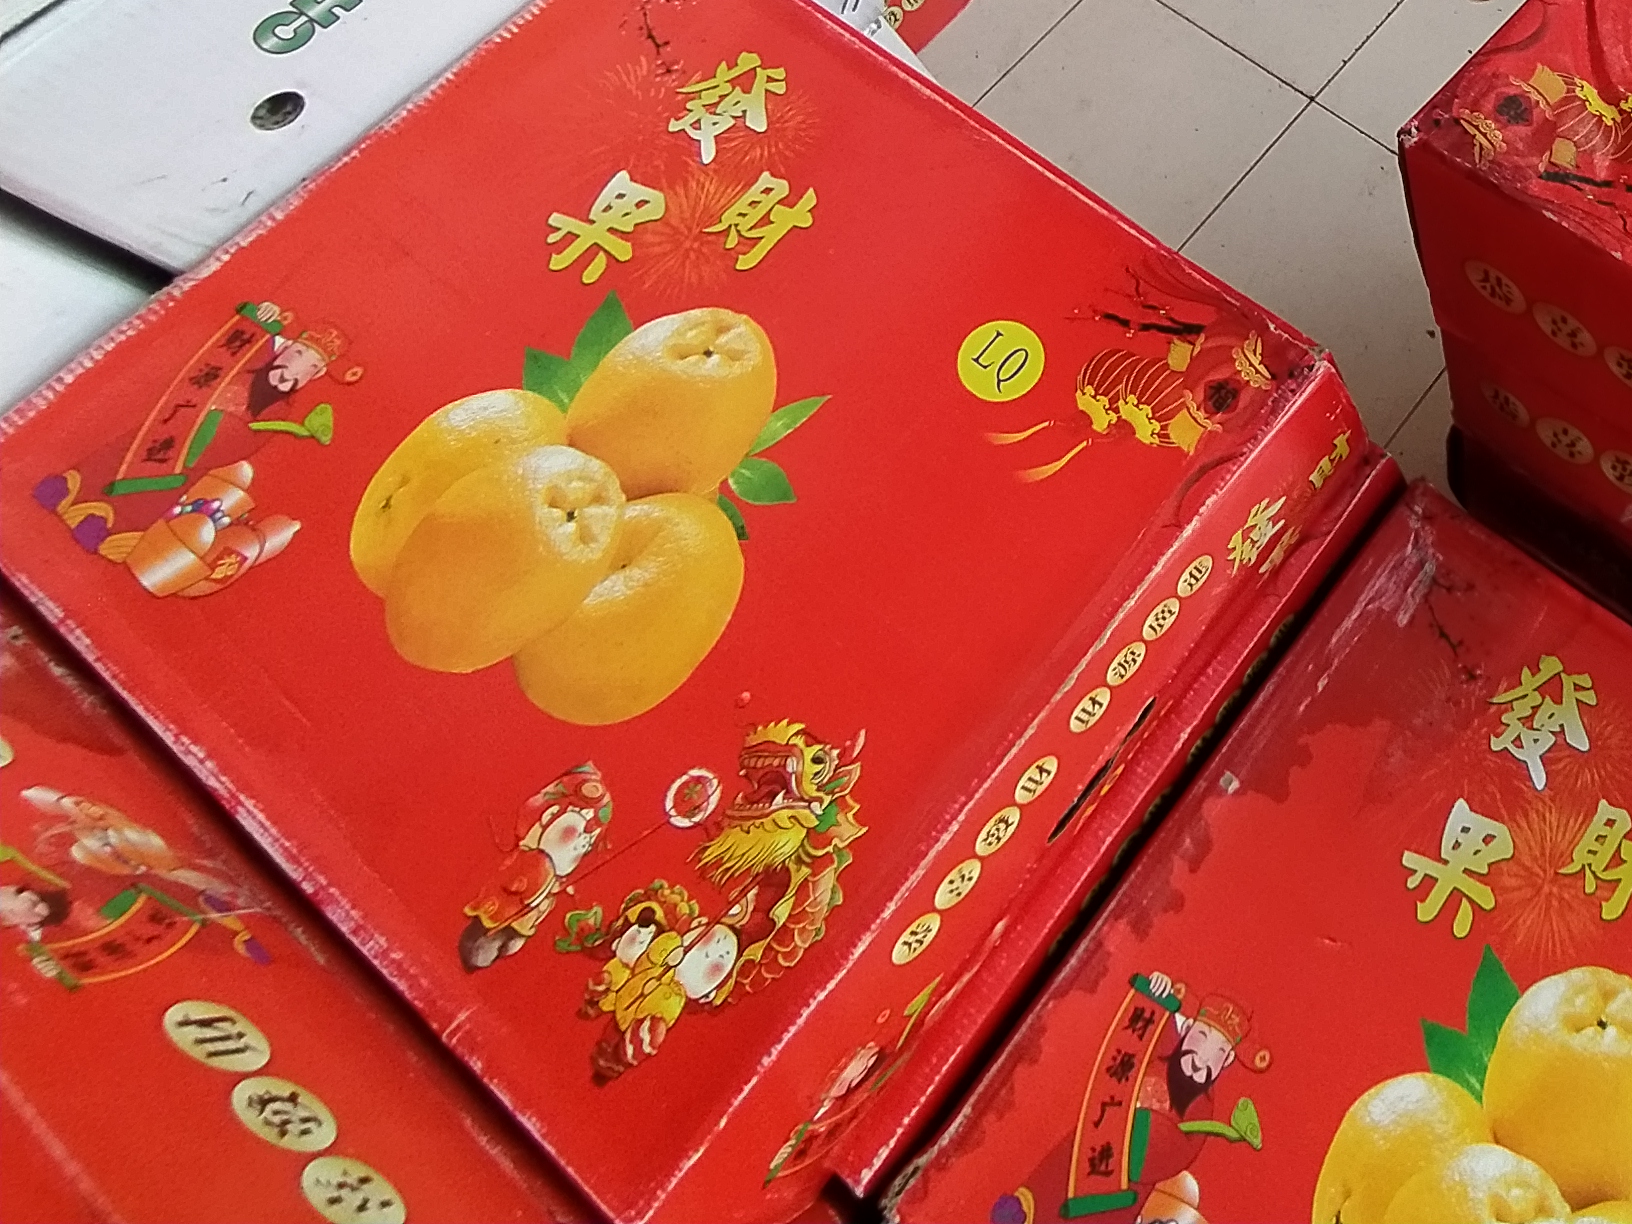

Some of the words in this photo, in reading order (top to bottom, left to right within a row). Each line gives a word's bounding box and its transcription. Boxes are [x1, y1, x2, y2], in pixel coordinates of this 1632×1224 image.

[668, 51, 787, 164] 發
[546, 168, 667, 285] 果
[702, 170, 819, 271] 財
[970, 329, 1031, 395] LQ
[900, 759, 1054, 956] 恭喜發財
[1073, 561, 1211, 731] 財源廣進
[1487, 653, 1599, 791] 發
[1400, 796, 1516, 939] 果
